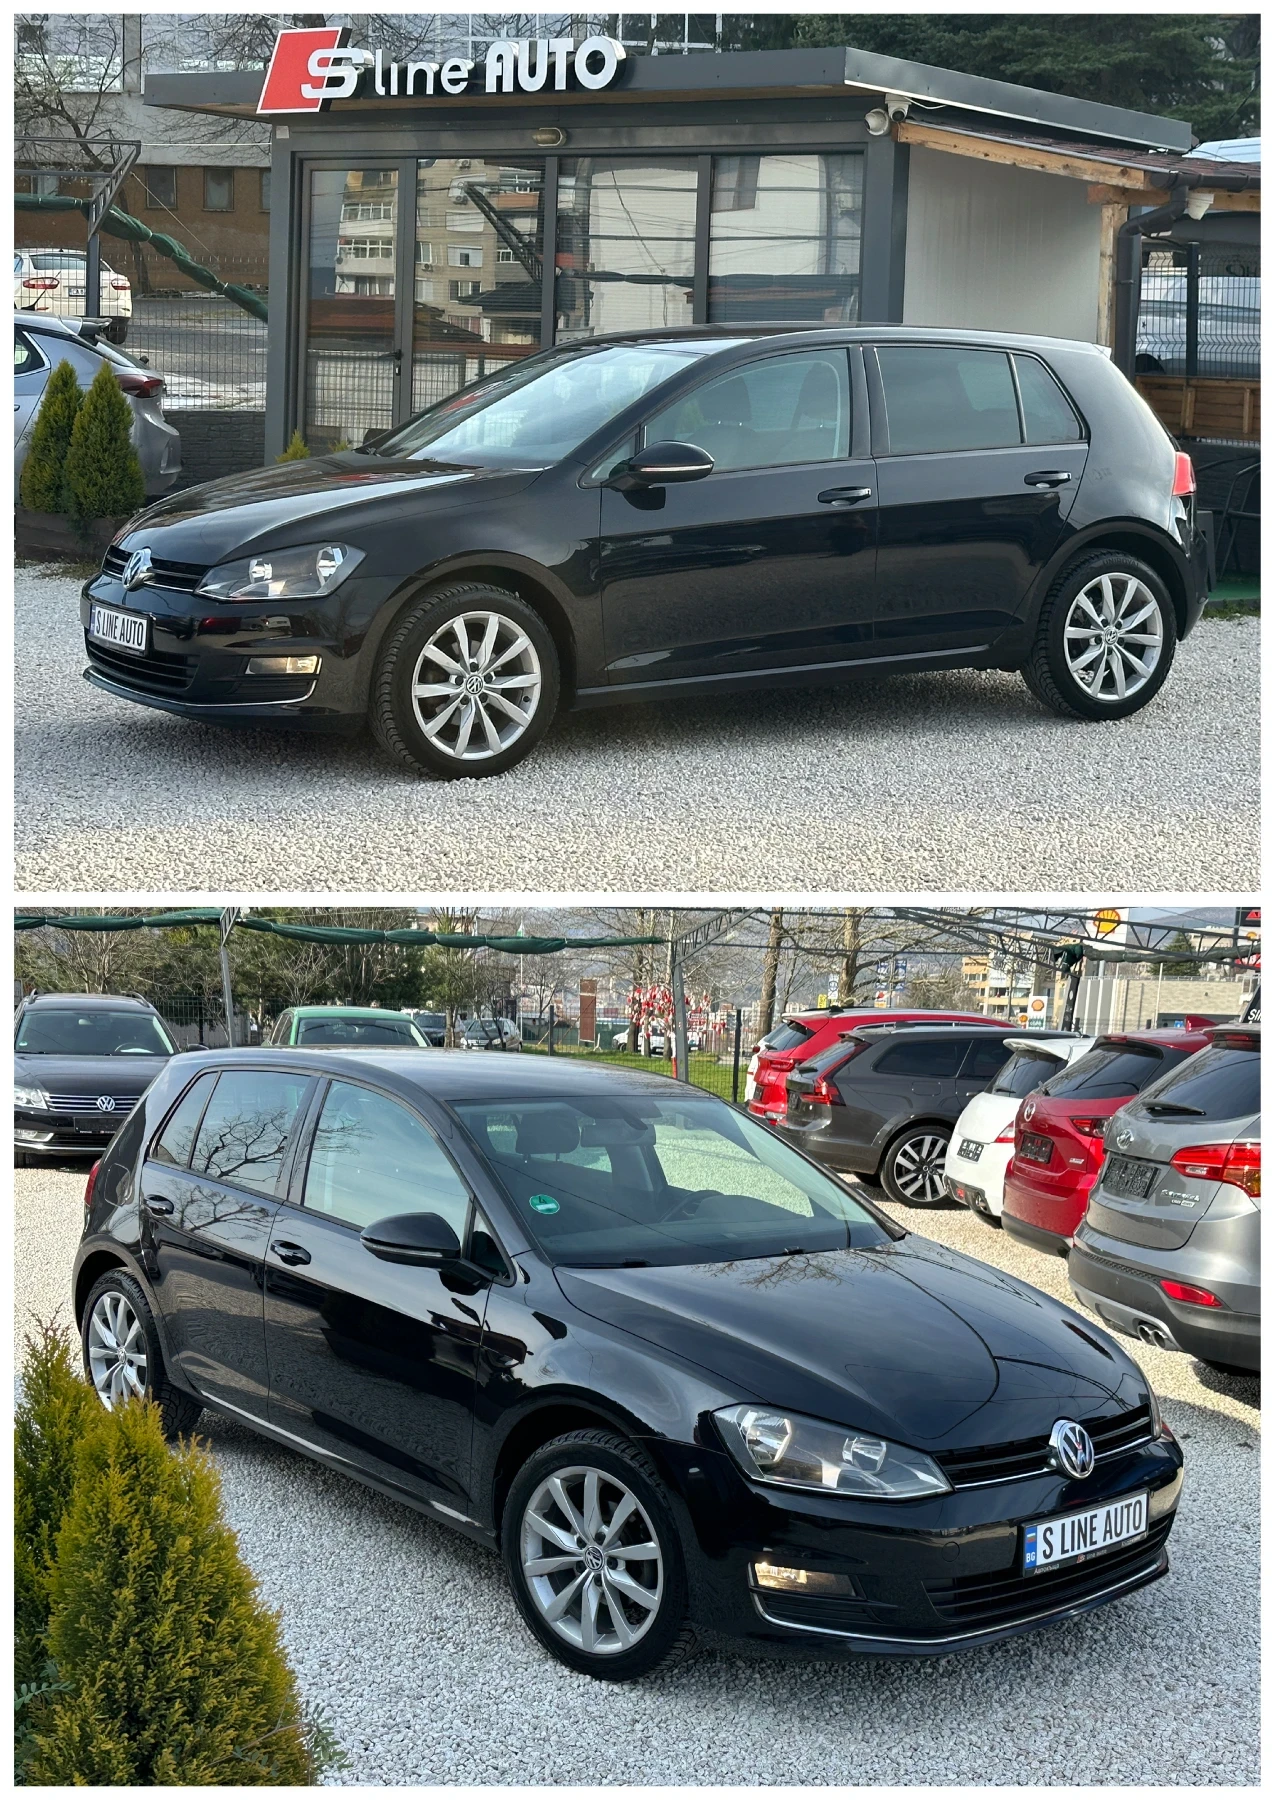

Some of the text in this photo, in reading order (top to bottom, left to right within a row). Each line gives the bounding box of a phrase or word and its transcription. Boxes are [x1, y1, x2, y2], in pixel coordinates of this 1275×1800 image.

[301, 36, 621, 98] S line AUTO
[96, 610, 144, 646] S LINE AUTO
[1042, 1499, 1143, 1560] S LINE AUTO
[1025, 1551, 1036, 1563] BG
